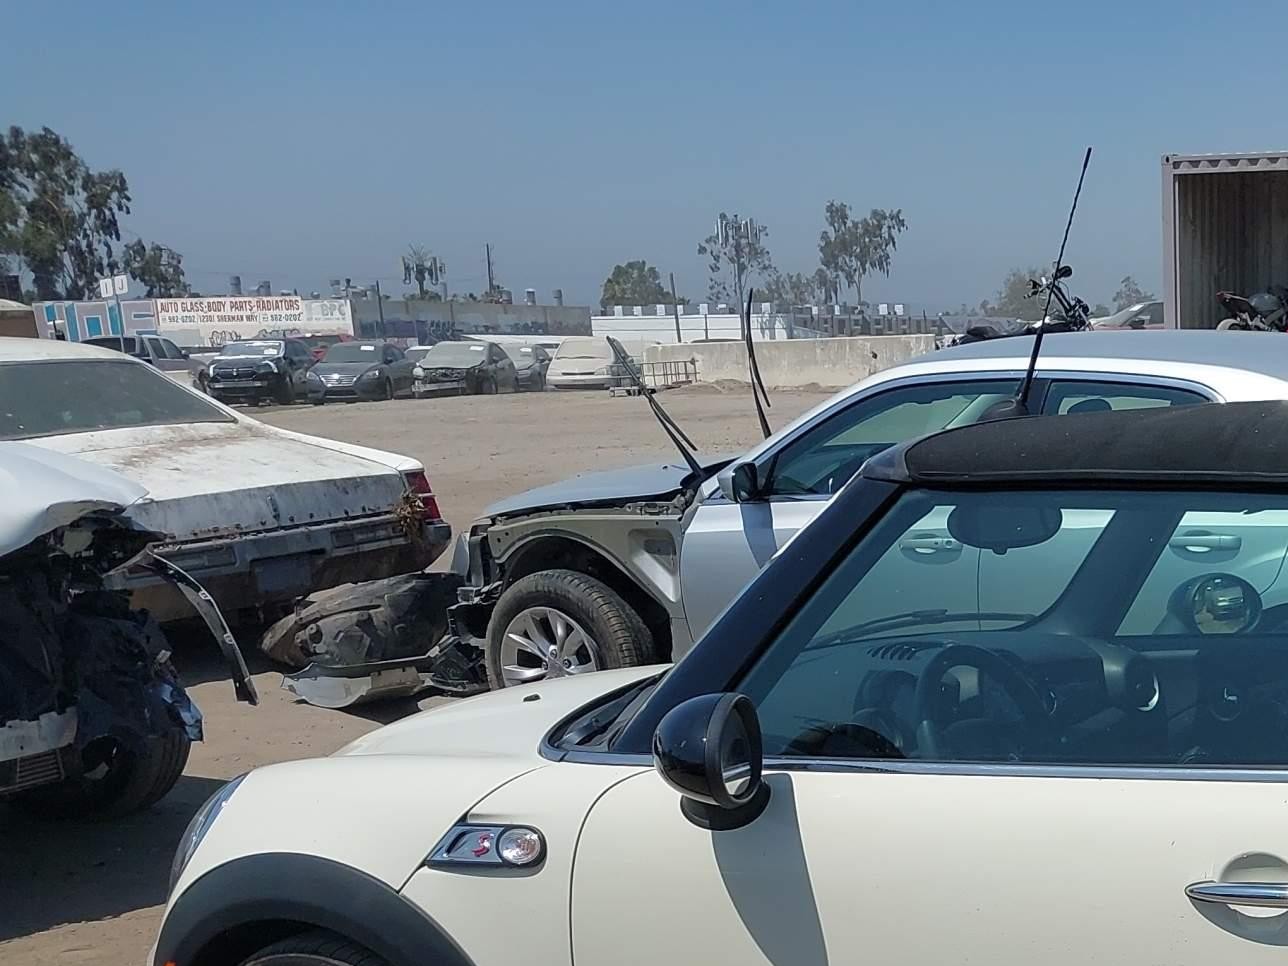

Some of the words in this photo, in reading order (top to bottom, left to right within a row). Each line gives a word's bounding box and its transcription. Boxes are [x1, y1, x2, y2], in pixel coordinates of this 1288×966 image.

[160, 302, 179, 313] AUTO
[216, 315, 244, 323] SHERMAN
[472, 831, 494, 857] S
